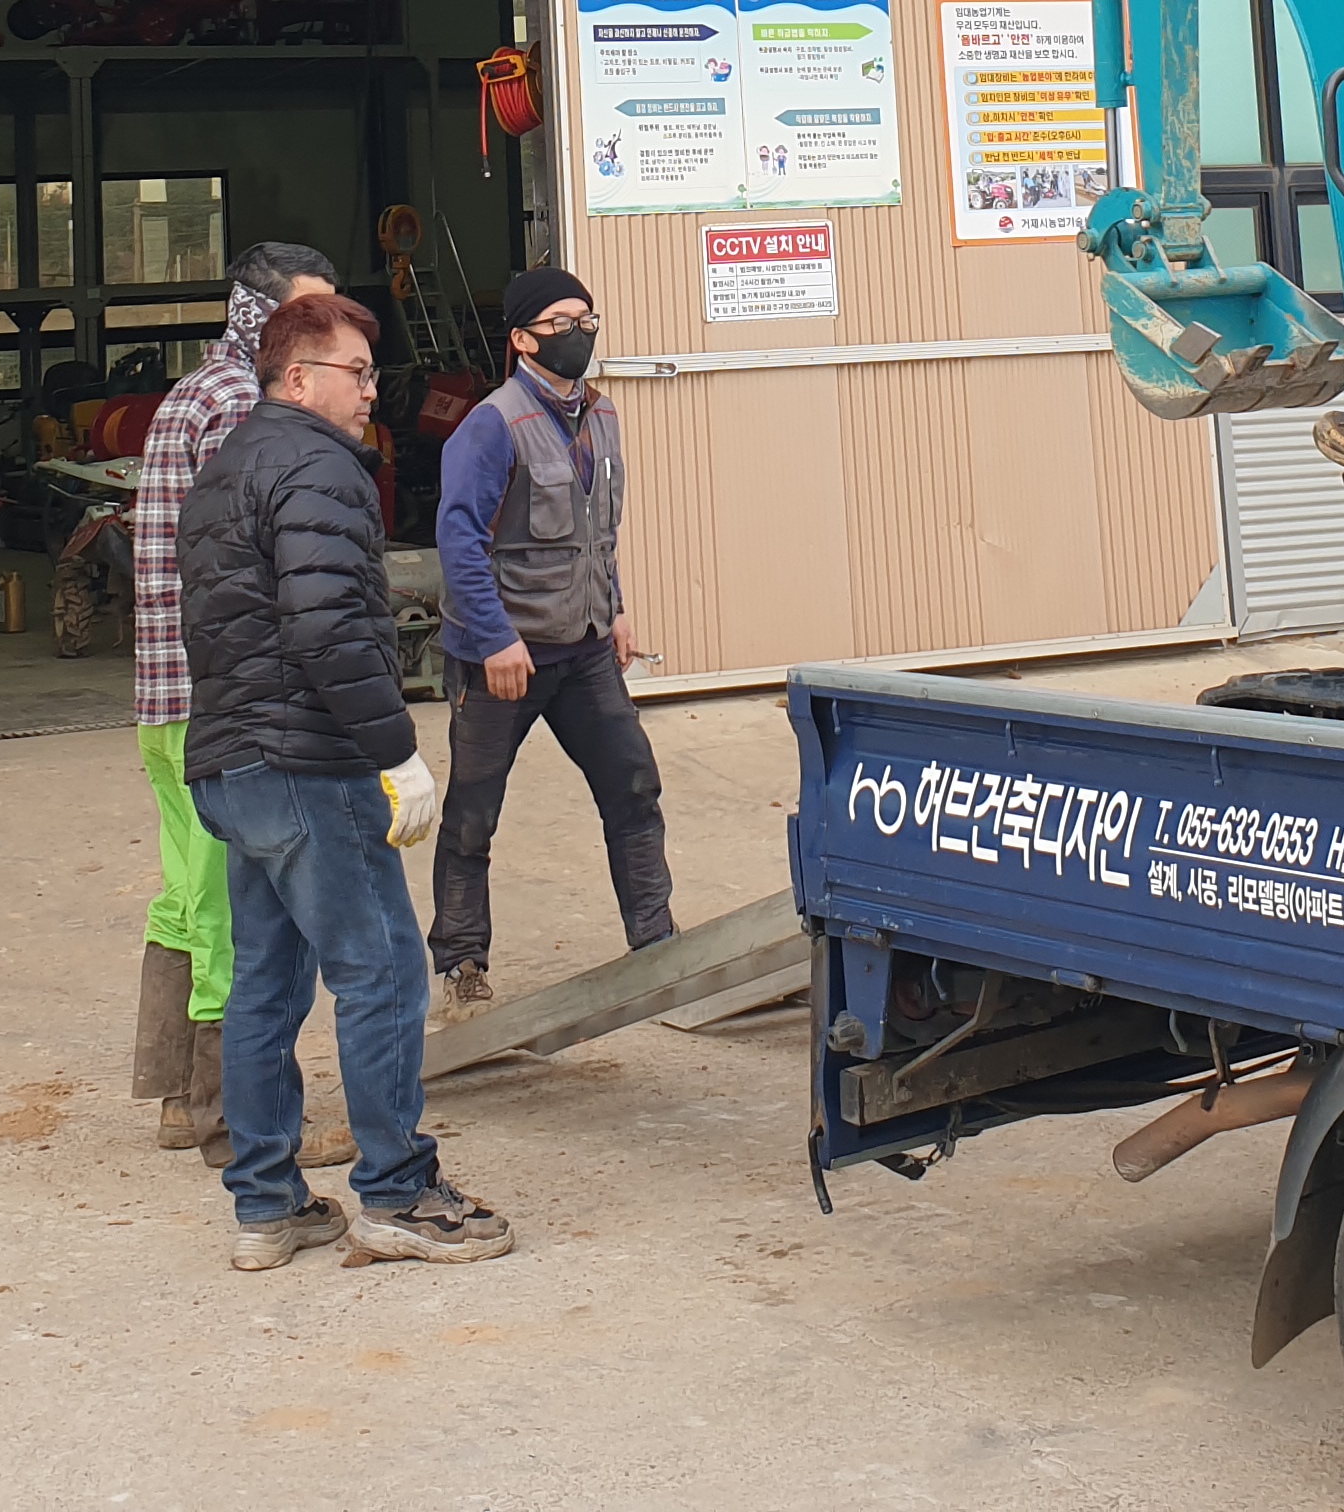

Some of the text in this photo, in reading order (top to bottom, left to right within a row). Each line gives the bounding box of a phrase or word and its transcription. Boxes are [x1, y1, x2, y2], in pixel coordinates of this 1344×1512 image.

[955, 7, 1011, 18] 임대농업기계는
[956, 20, 1042, 30] 우리 모두의 재산입니다.
[1036, 36, 1051, 45] 하게
[1053, 35, 1084, 45] 이용하여
[958, 48, 1078, 60] 소중한 생명과 재산을 보호 합시다.
[1011, 152, 1034, 161] 반드시
[1021, 216, 1088, 229] 거제시농업기술
[713, 233, 825, 256] CCTV 설치 안내
[914, 760, 1143, 887] 허브건축디자인
[1155, 800, 1171, 844] T.
[1176, 803, 1318, 867] 055-633-0553
[1147, 860, 1182, 901] 설계,
[1187, 867, 1223, 910] 시공,
